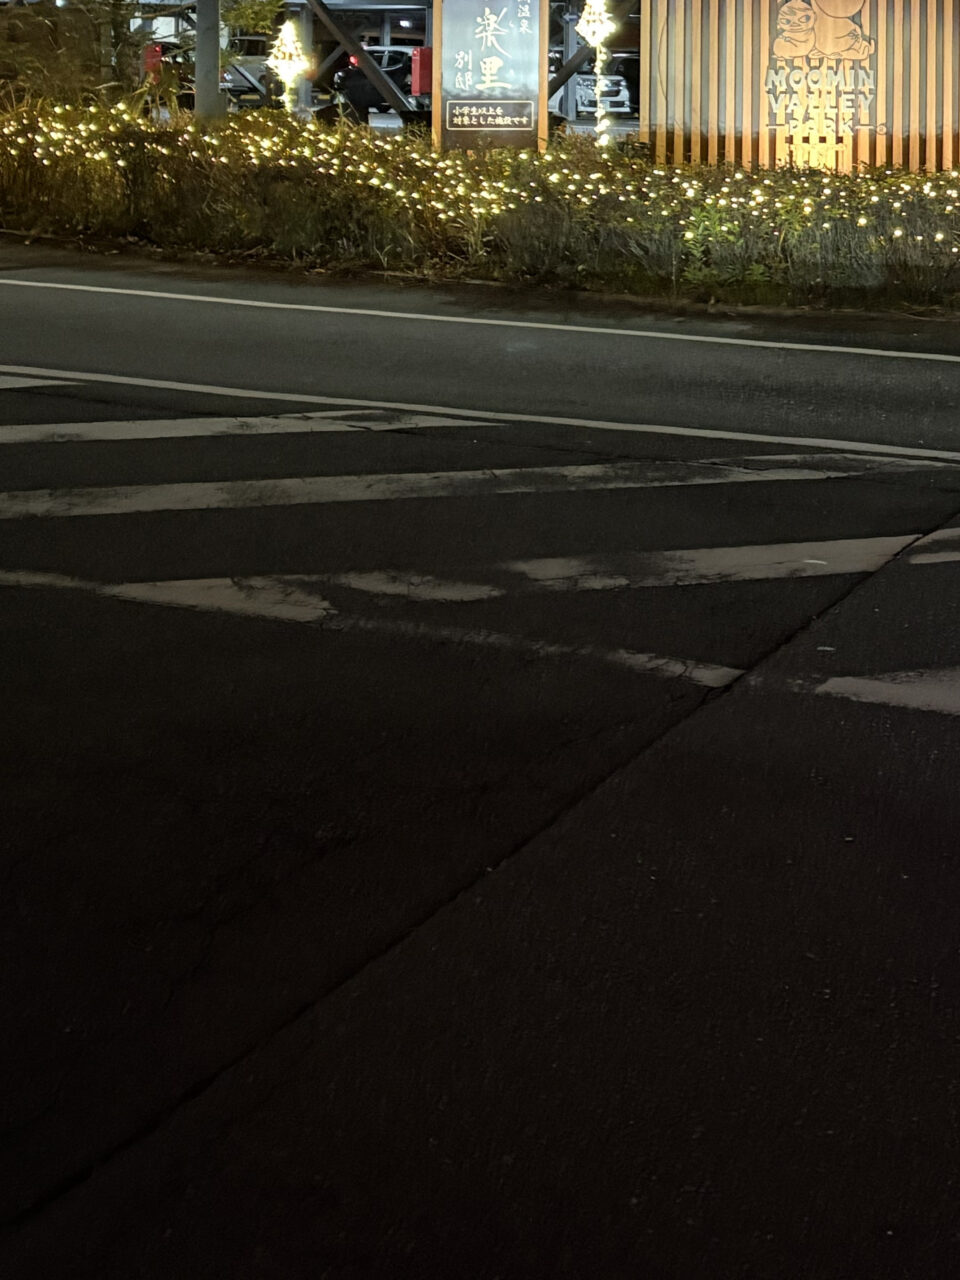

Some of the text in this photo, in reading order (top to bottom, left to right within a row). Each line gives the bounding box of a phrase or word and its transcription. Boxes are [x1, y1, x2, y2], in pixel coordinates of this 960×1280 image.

[454, 50, 472, 90] 別邸
[766, 69, 874, 89] MOOMIN
[769, 94, 874, 113] VALLEY
[789, 120, 854, 136] PARK
